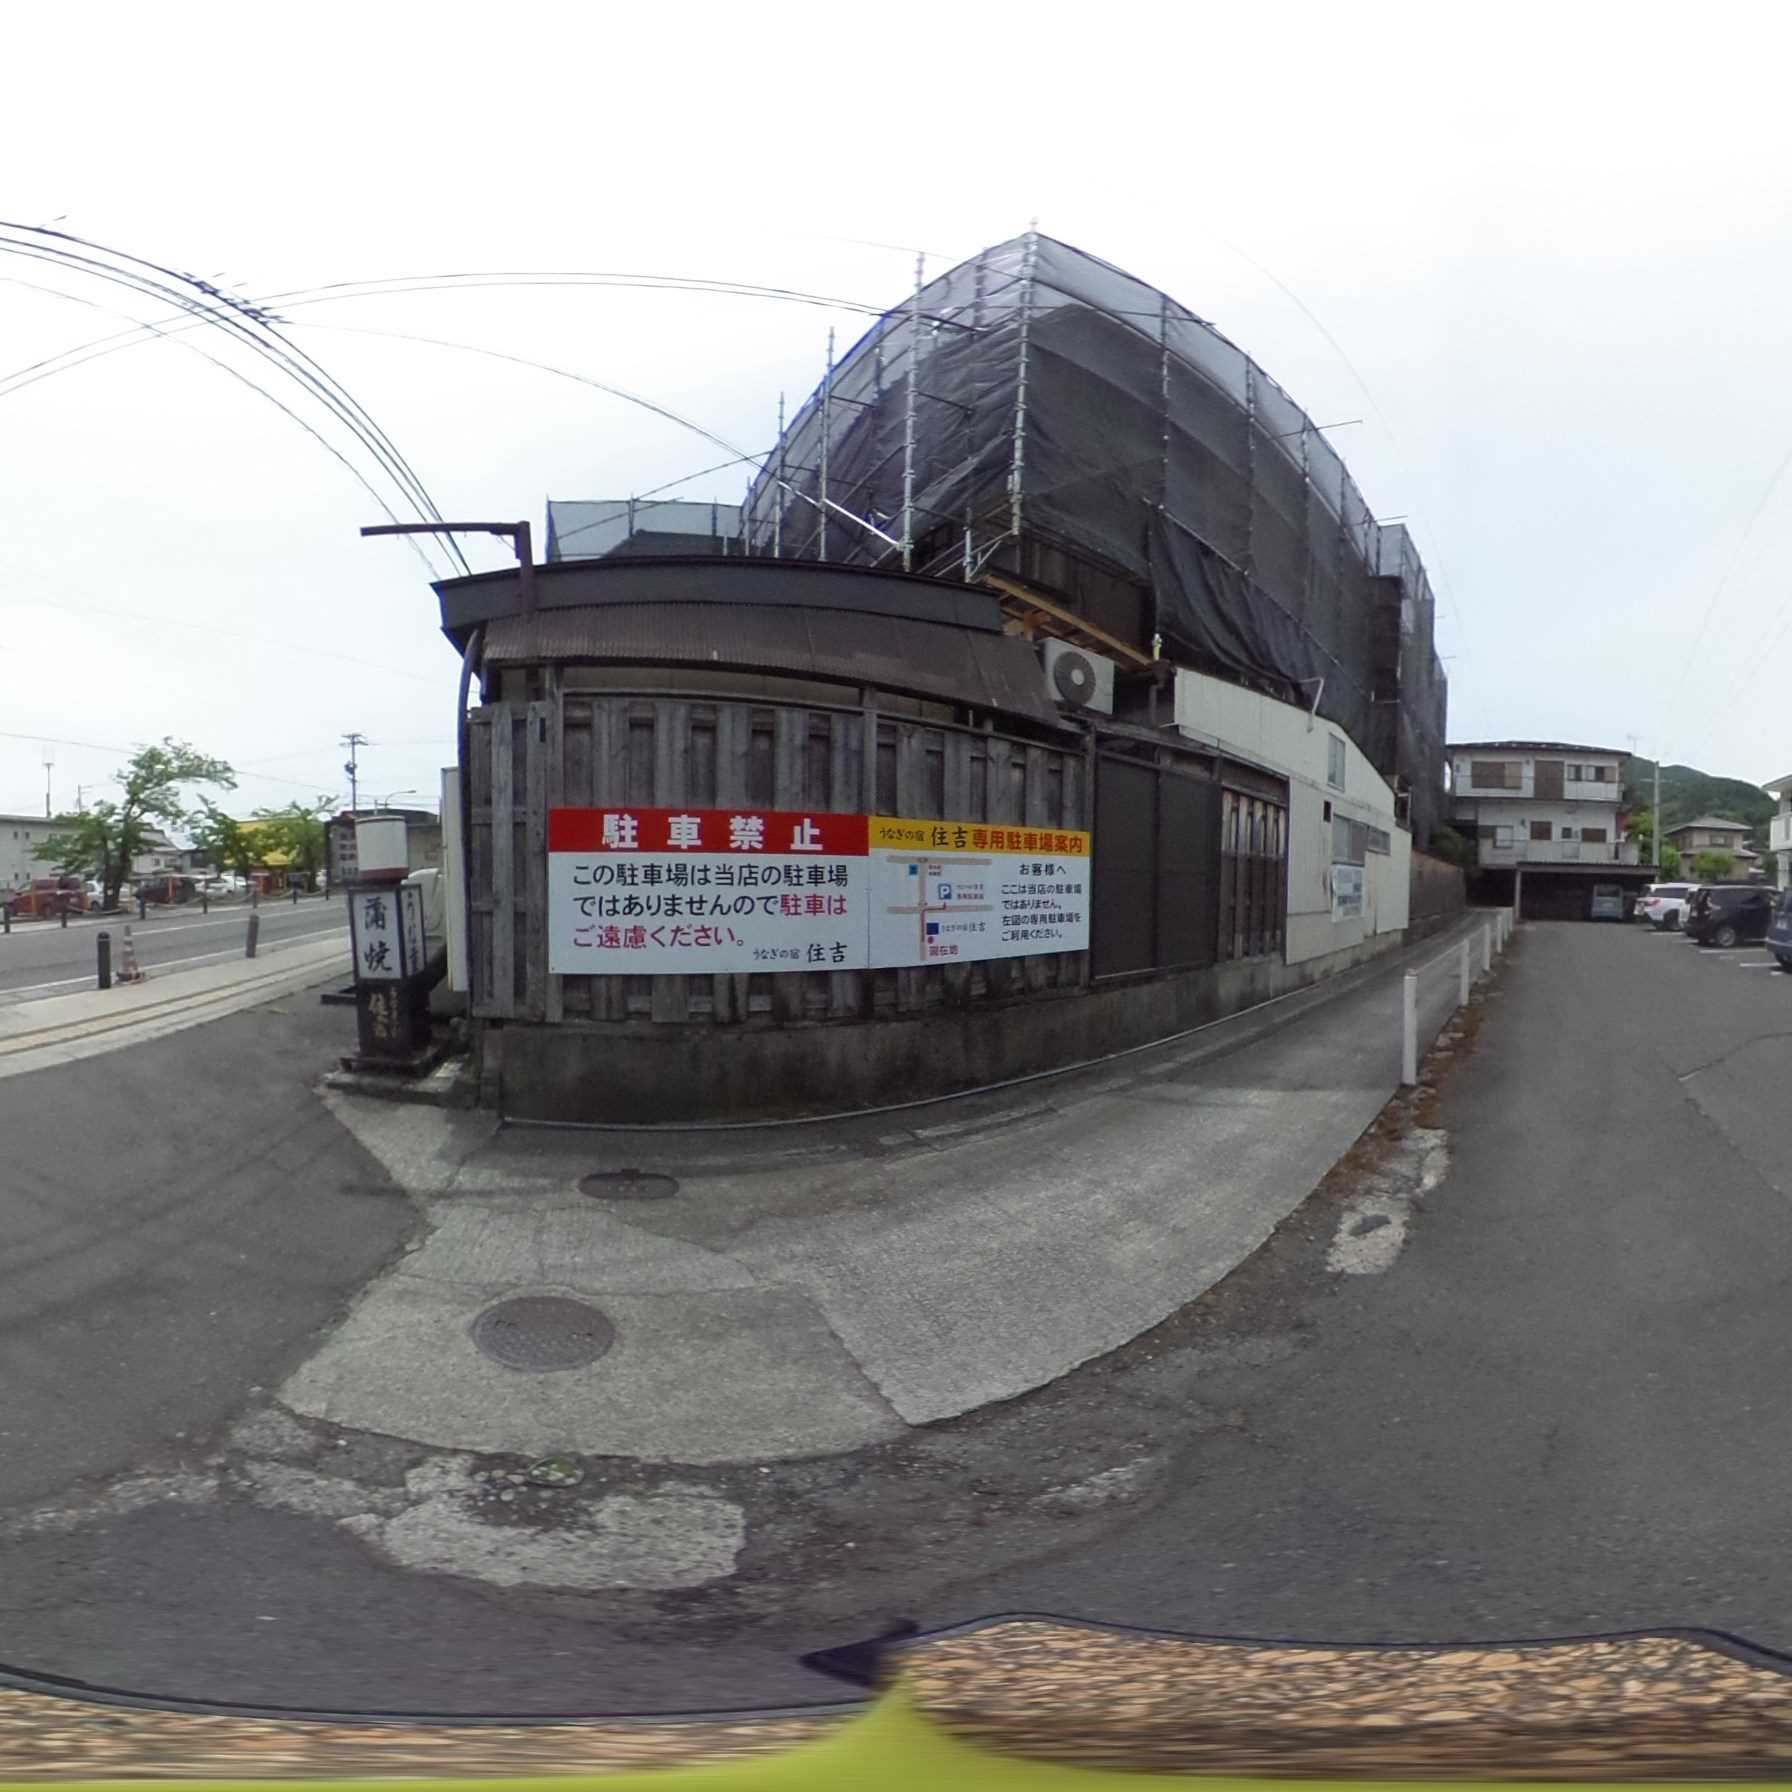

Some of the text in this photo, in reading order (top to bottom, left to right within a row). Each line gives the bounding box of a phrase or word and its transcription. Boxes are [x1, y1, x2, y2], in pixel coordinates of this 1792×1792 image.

[602, 814, 823, 851] 駐車禁止
[880, 826, 1083, 853] うなぎの宿 住吉 専用駐車場案内
[573, 863, 849, 887] この駐車場は当店の駐車場
[1019, 863, 1067, 876] お客様へ
[1001, 884, 1082, 895] ここは当店の駐車場
[573, 895, 848, 917] ではありませんので駐車は
[364, 896, 393, 972] 蒲焼
[573, 924, 745, 949] ご遠慮ください。
[753, 941, 849, 964] うなぎの宿 住吉
